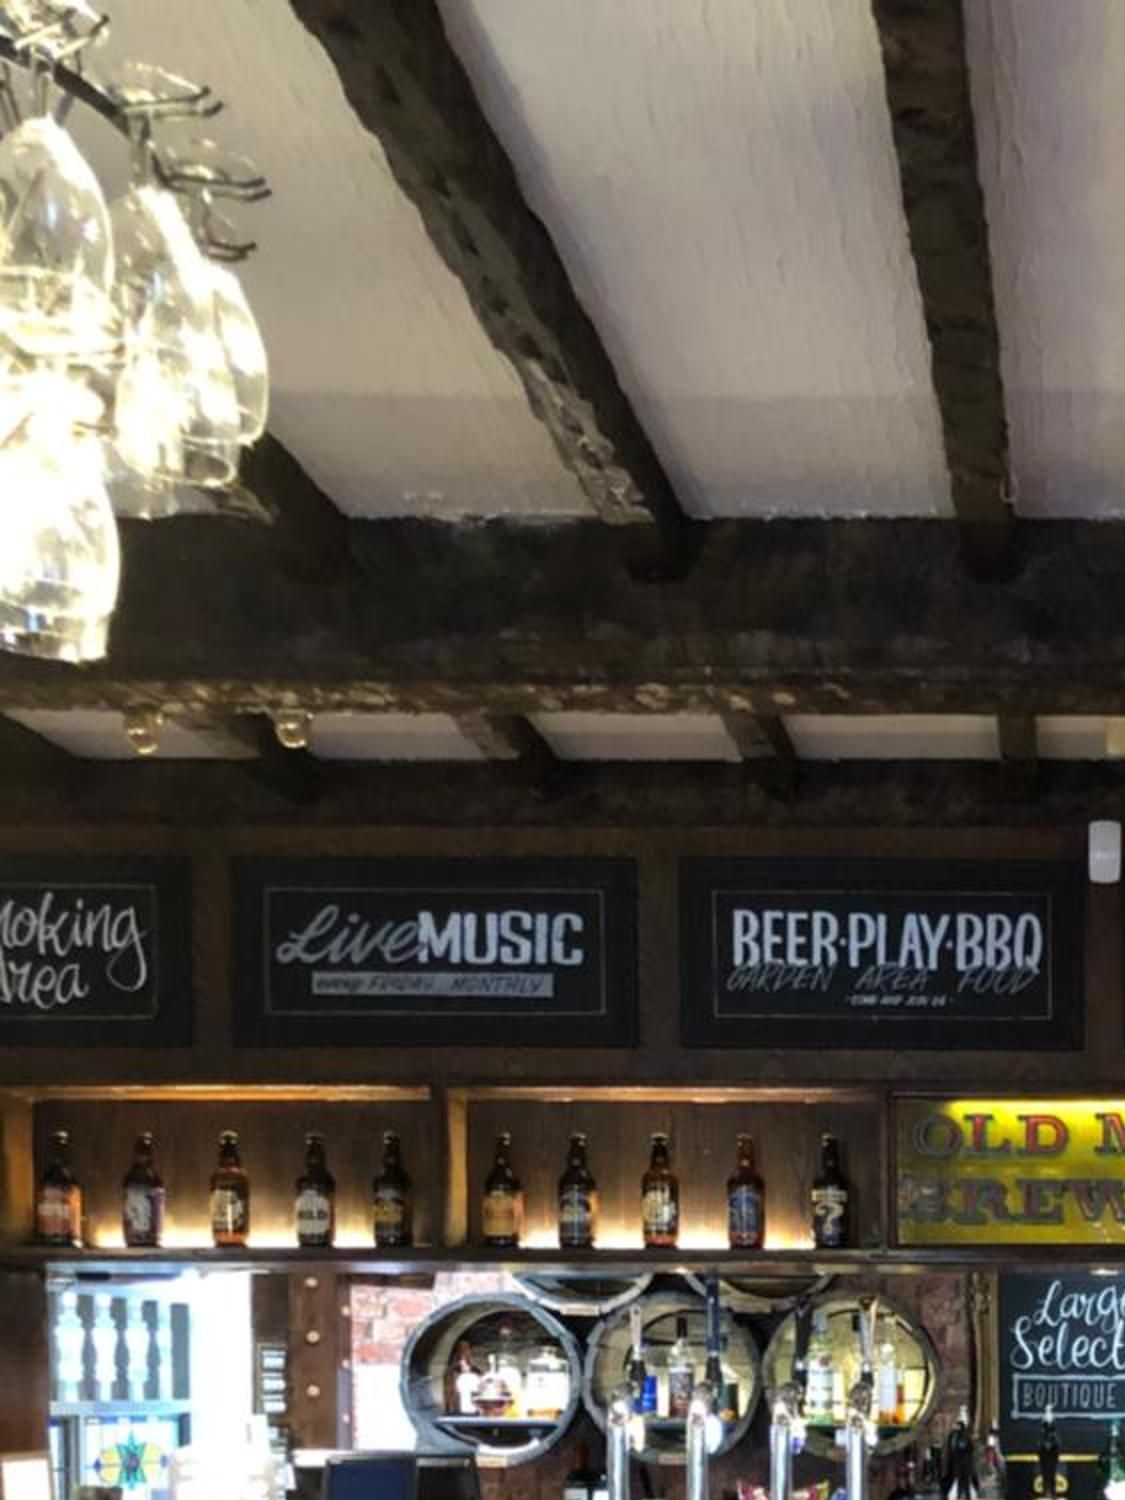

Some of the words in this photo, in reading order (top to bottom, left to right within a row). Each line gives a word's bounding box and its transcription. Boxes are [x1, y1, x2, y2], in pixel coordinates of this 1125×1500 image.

[276, 904, 422, 964] Live
[417, 911, 583, 965] MUSIC
[913, 1113, 1070, 1158] OLD
[1022, 1383, 1116, 1408] BOUTIQUE
